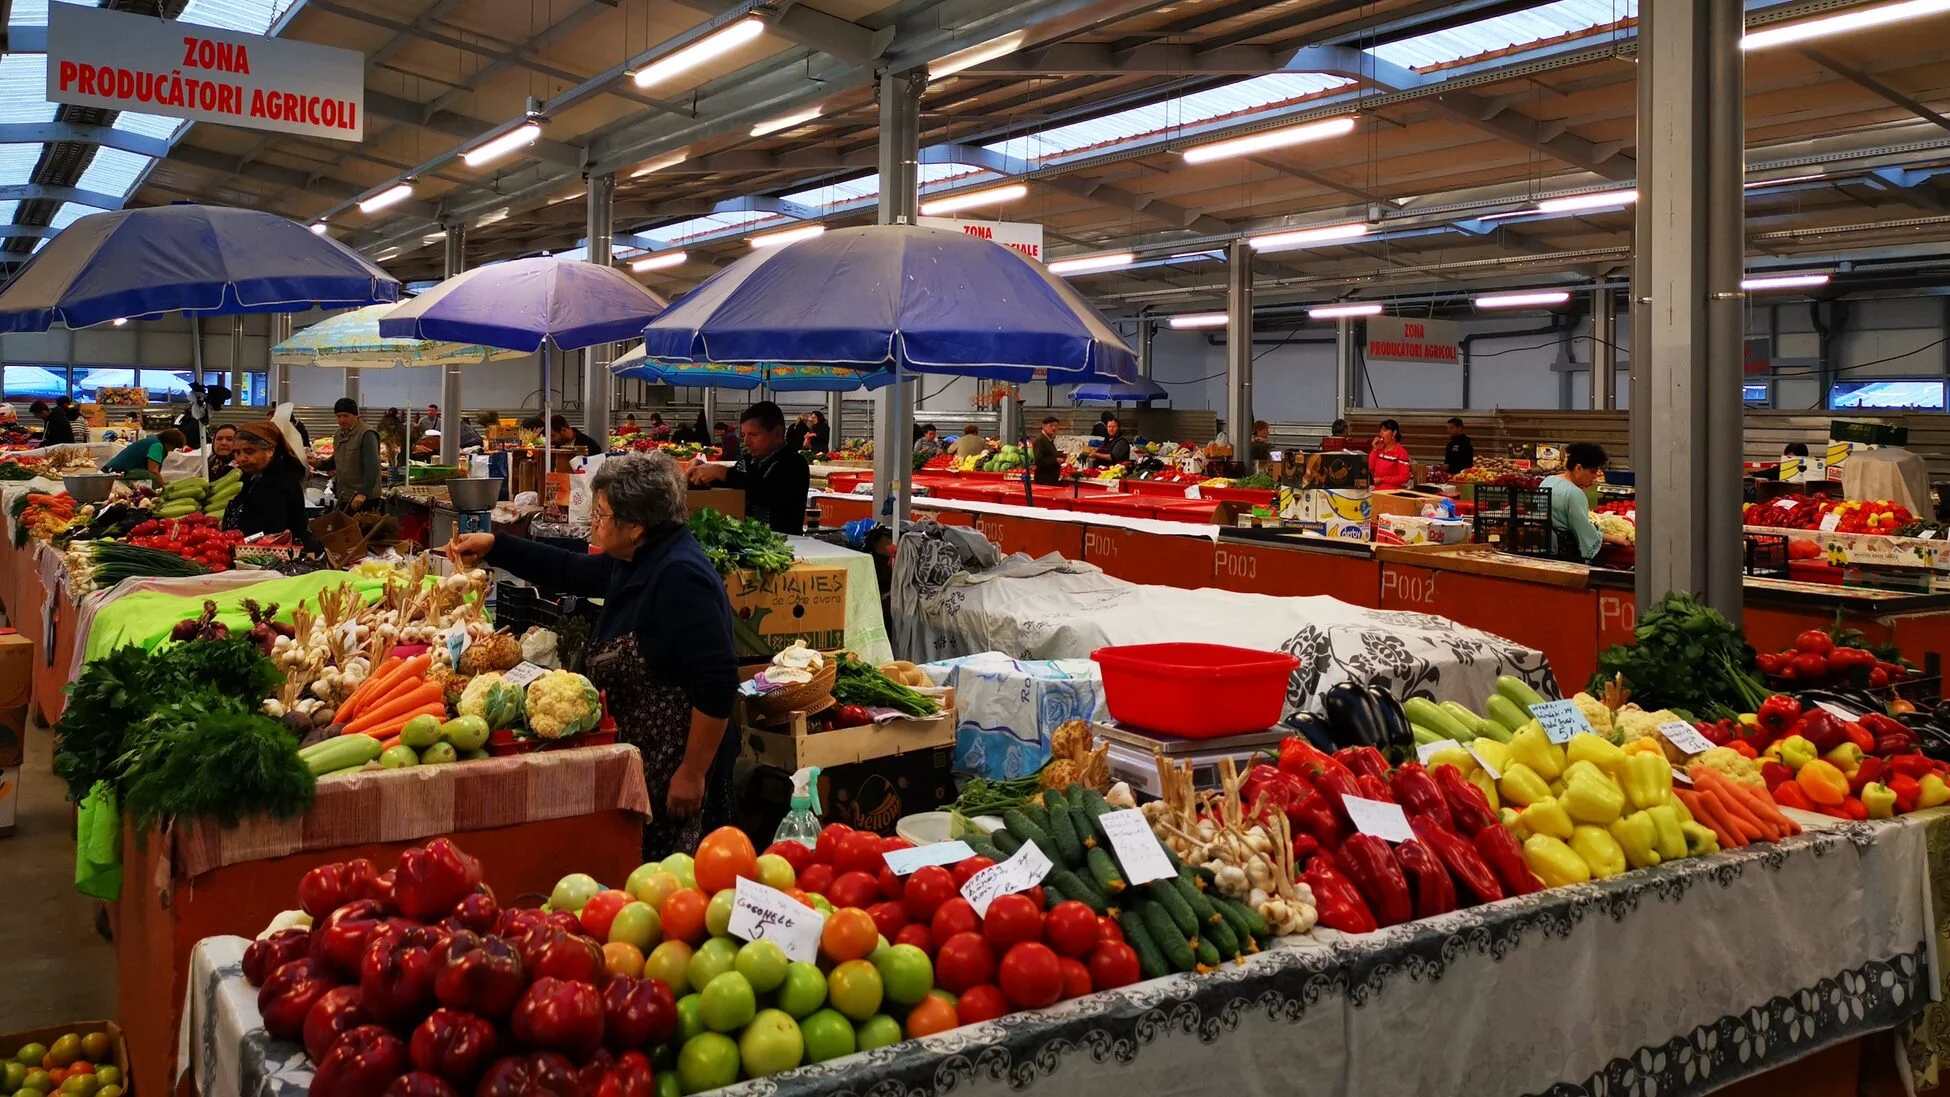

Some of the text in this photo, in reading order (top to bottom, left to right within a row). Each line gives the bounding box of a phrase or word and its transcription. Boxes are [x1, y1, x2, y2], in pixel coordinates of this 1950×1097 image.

[183, 36, 250, 75] ZONA
[250, 88, 356, 130] AGRICOLI
[963, 225, 993, 240] ZONA
[1404, 323, 1424, 338] ZONA
[1424, 344, 1456, 360] AGRICOLI
[1341, 526, 1361, 540] derby
[1214, 550, 1256, 579] P003
[1381, 570, 1435, 603] P002
[1599, 596, 1635, 631] P0
